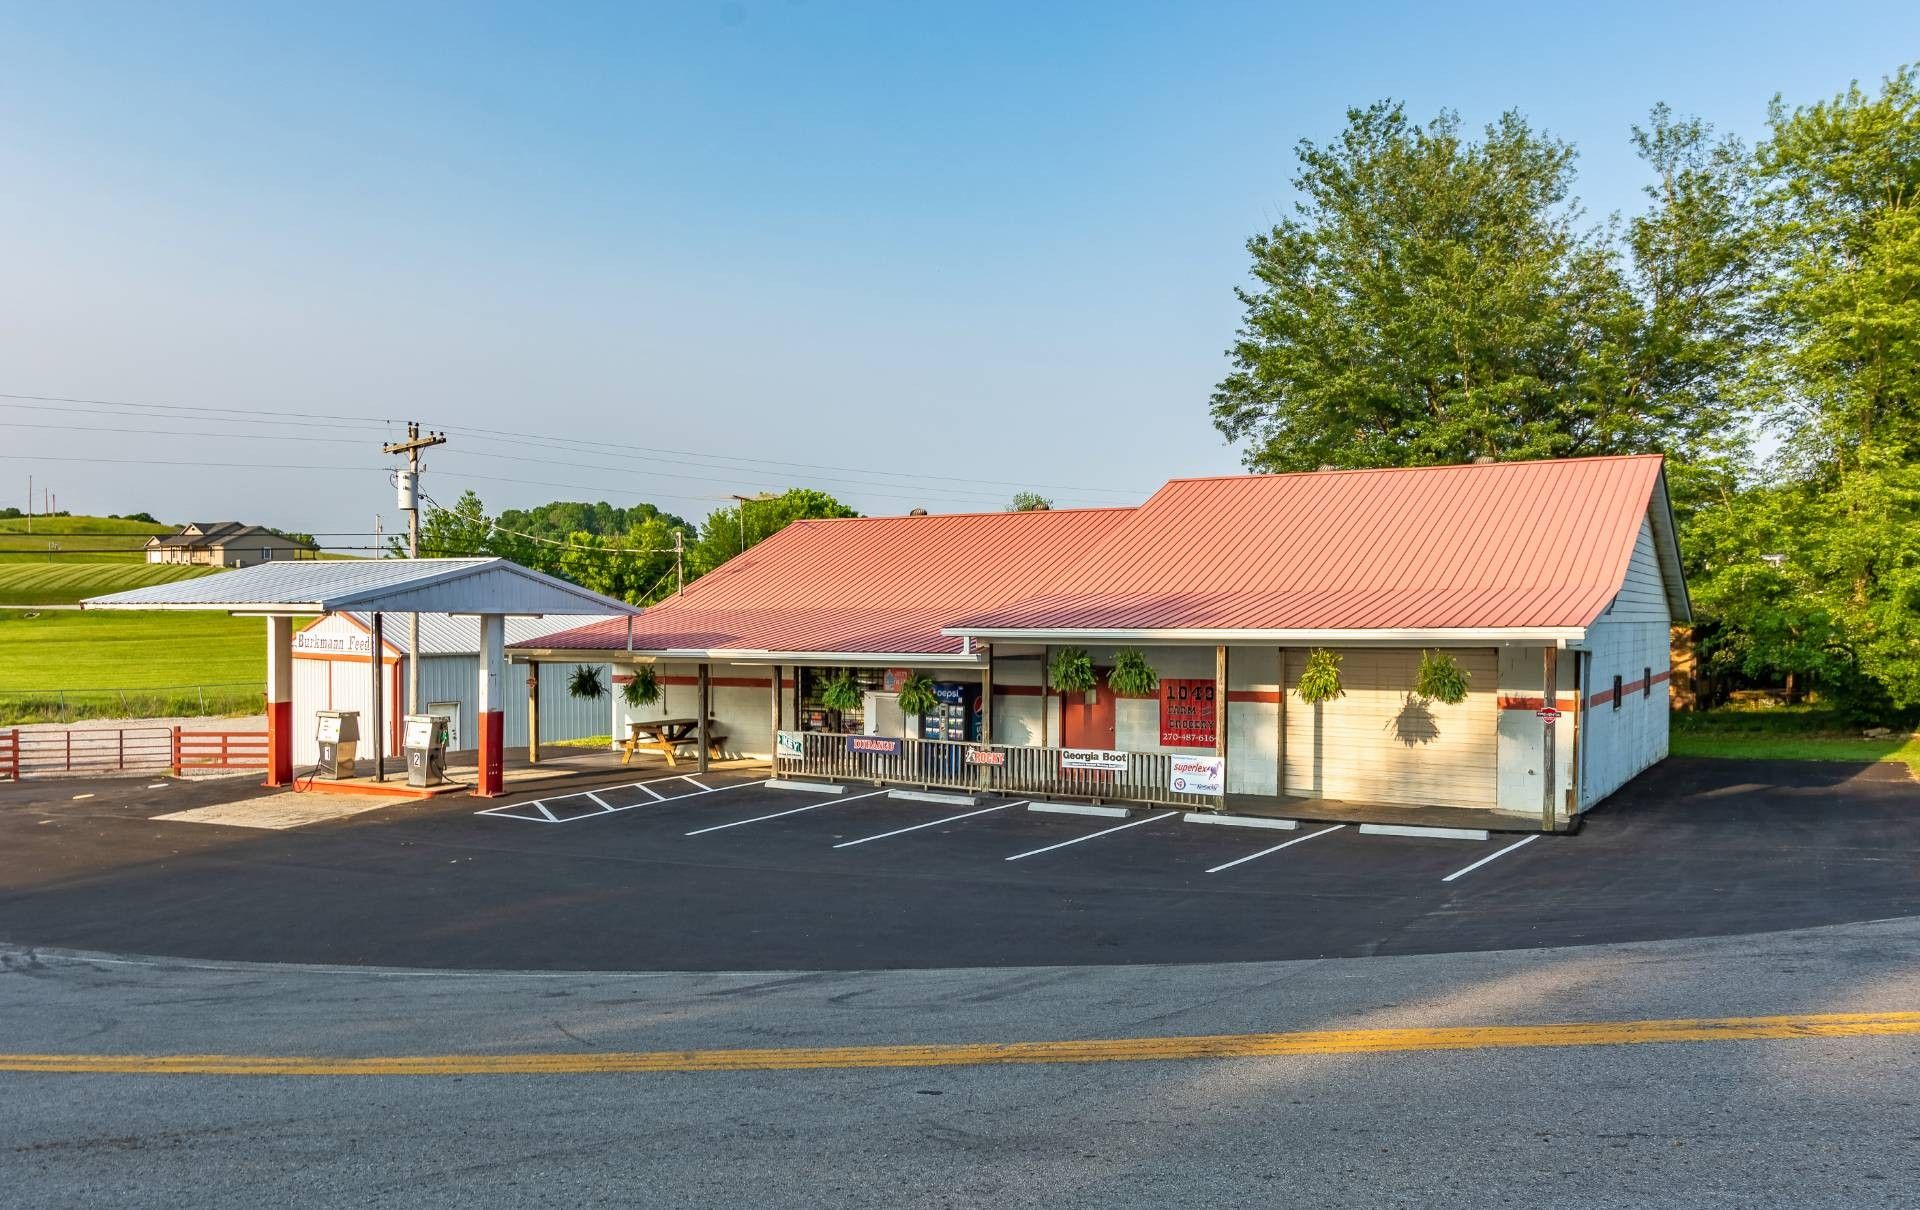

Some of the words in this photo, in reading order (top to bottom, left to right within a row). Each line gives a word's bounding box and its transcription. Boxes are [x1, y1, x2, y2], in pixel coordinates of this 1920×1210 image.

[298, 633, 344, 650] Burkmann
[1163, 733, 1216, 742] 270-487-616
[325, 748, 330, 759] 1
[413, 753, 420, 766] 2
[975, 751, 1005, 765] ROCKY
[1063, 750, 1099, 762] Georgia
[1102, 752, 1127, 762] Boot
